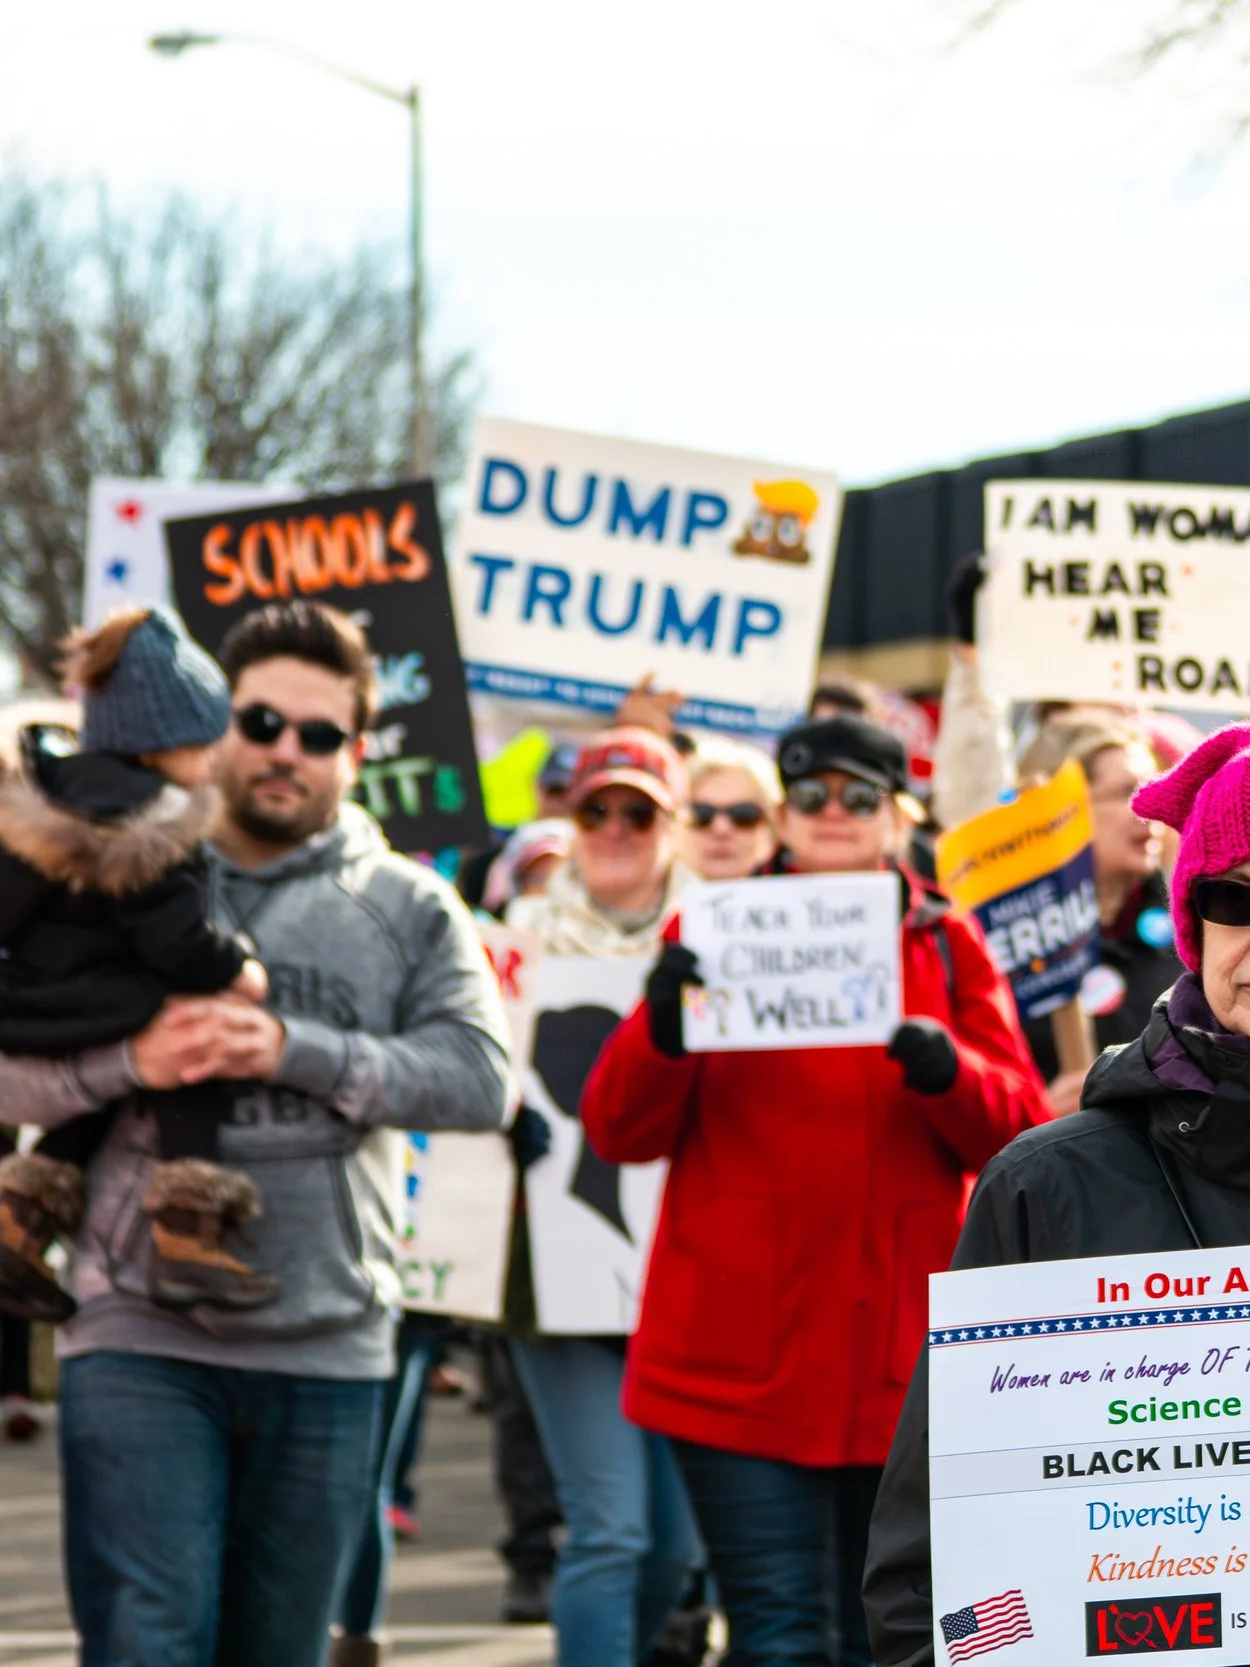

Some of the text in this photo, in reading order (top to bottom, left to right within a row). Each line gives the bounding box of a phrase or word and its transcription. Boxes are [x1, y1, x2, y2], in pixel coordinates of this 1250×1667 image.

[477, 457, 730, 547] DUMP
[1000, 497, 1015, 530] I
[1028, 496, 1098, 532] AM
[202, 501, 431, 606] SCHOOLS
[1023, 559, 1169, 598] HEAR
[467, 552, 783, 656] TRUMP
[1087, 606, 1161, 643] ME
[705, 891, 865, 934] TEACH YOUR
[720, 937, 865, 980] CHILDREN
[746, 986, 850, 1031] WELL
[1097, 1277, 1130, 1303] In
[1144, 1273, 1211, 1299] Our
[990, 1363, 1051, 1393] Women
[1059, 1369, 1092, 1385] are
[1100, 1361, 1116, 1383] in
[1124, 1355, 1191, 1387] charge
[1200, 1345, 1240, 1375] OF
[1108, 1396, 1241, 1425] Science
[1042, 1446, 1161, 1479] BLACK
[1086, 1495, 1212, 1534] Diversity
[1221, 1494, 1241, 1521] is
[1087, 1545, 1218, 1583] Kindness
[1224, 1545, 1248, 1573] is
[1231, 1612, 1247, 1629] IS
